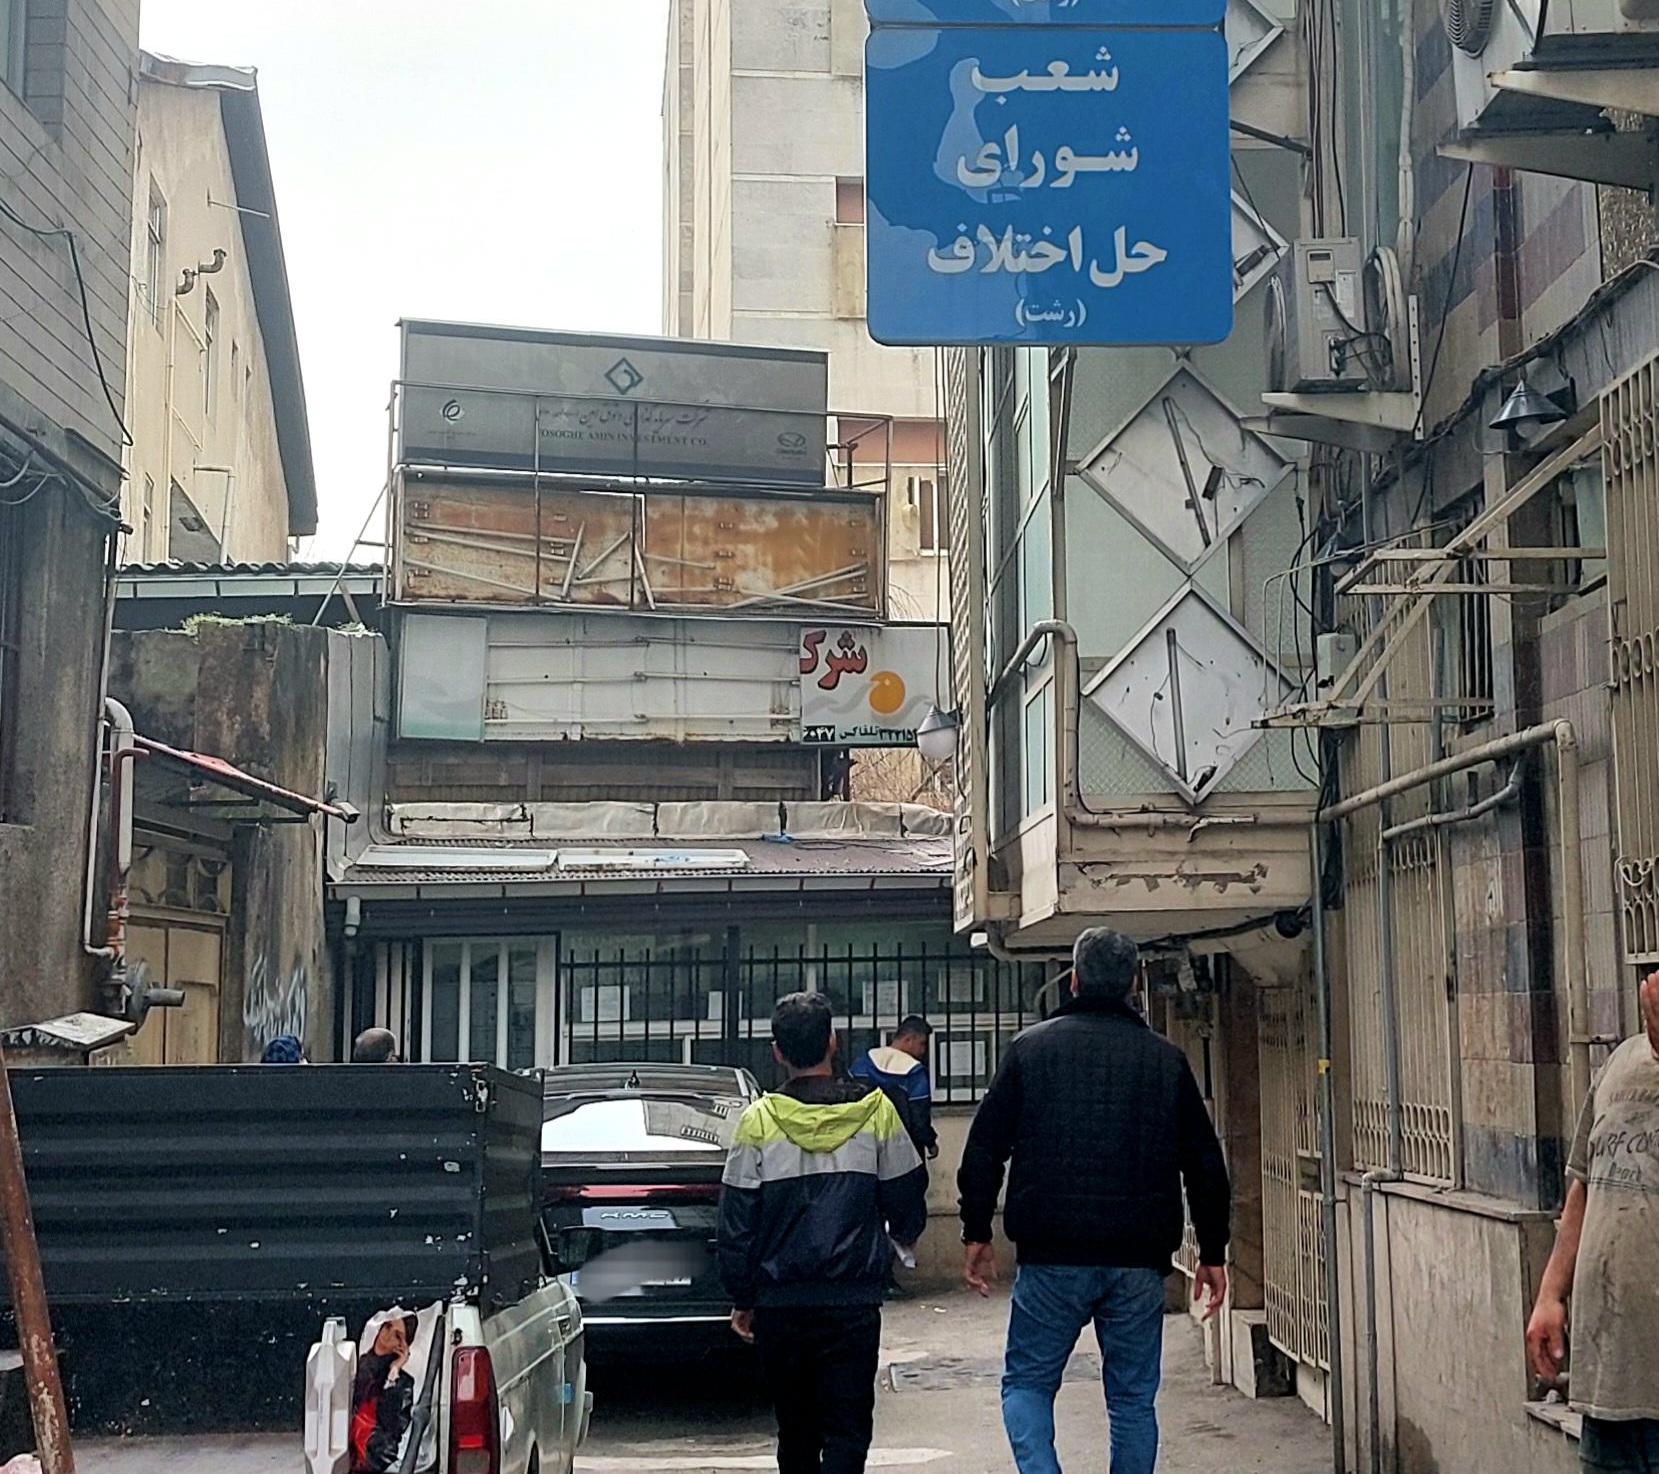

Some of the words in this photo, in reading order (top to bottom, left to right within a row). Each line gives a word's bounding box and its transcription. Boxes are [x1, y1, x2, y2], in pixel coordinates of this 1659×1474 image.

[970, 45, 1120, 105] شعب
[956, 124, 1139, 189] شورای
[927, 223, 1084, 275] اختلاف
[1089, 225, 1168, 288] حل
[1015, 297, 1087, 327] (رشت)
